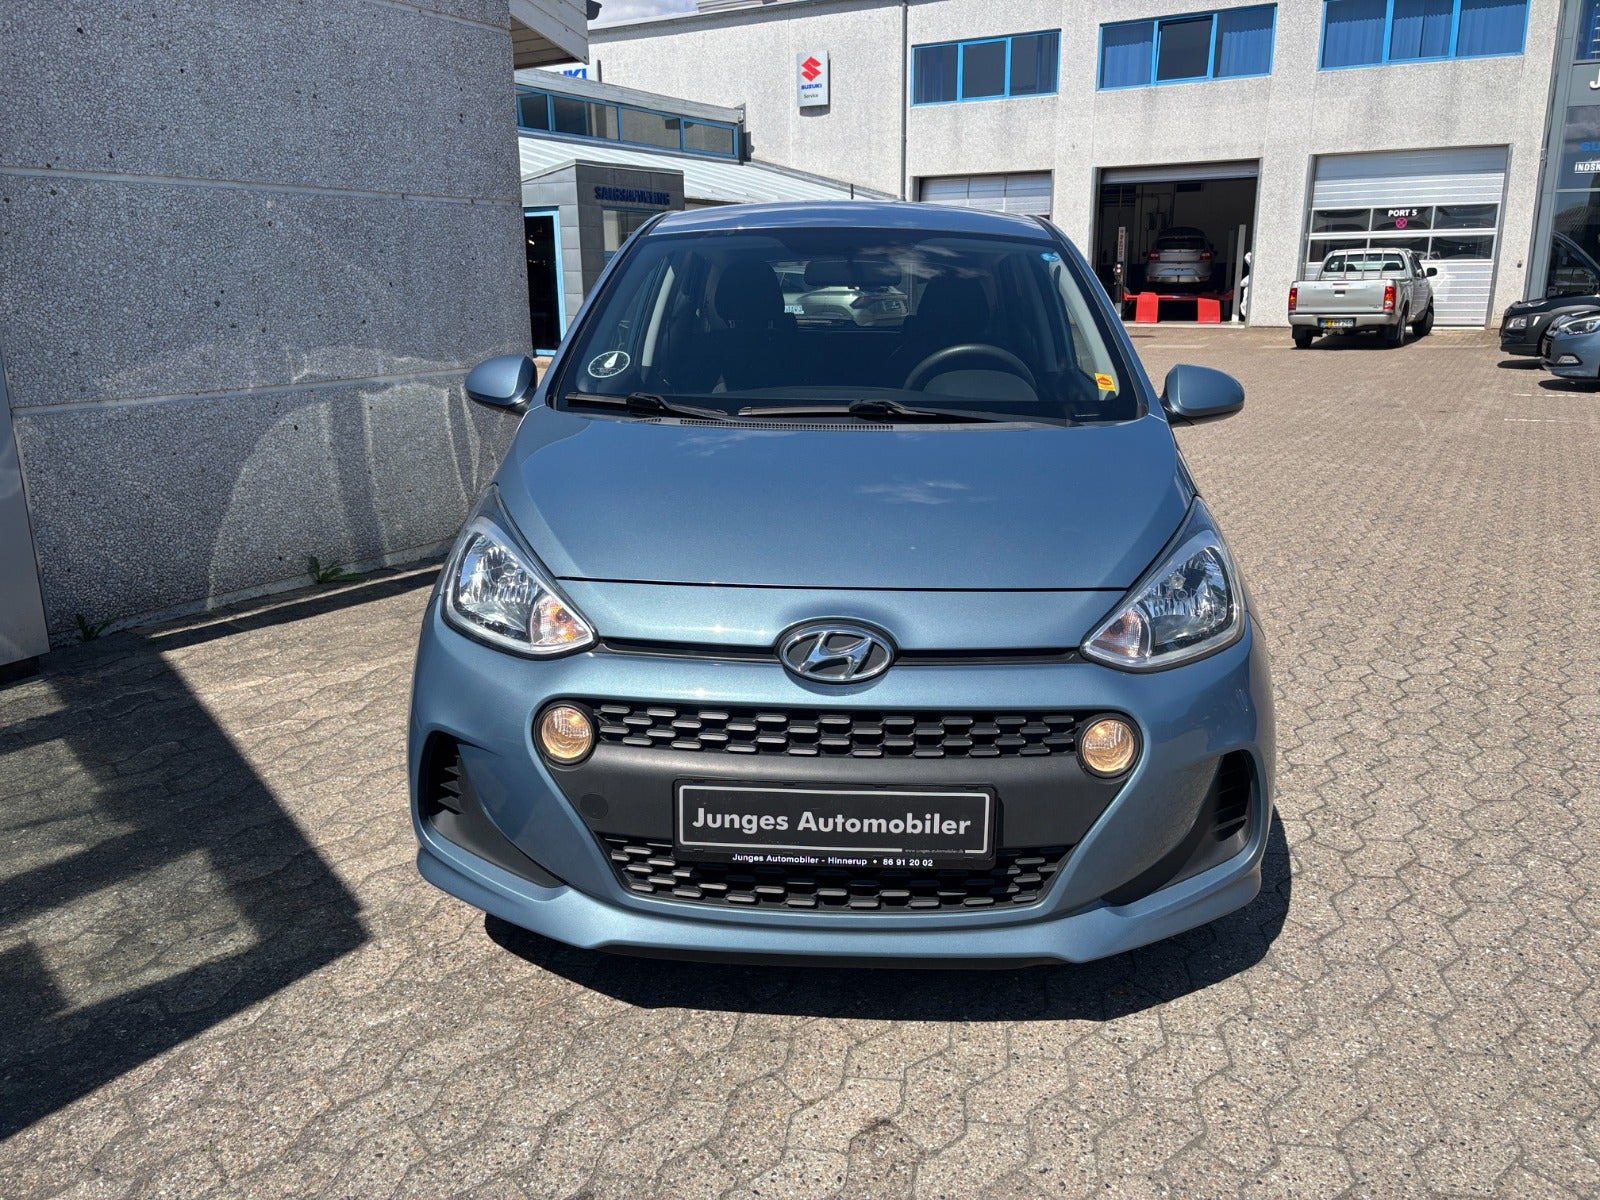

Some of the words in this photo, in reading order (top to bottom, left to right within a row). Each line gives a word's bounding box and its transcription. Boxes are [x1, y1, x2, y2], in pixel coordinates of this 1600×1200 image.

[1387, 209, 1410, 217] PORT
[692, 808, 789, 833] Junges
[797, 811, 971, 834] Automobiler
[732, 853, 764, 862] Junges
[766, 855, 819, 864] Automobiler
[828, 857, 867, 866] Hinnerup
[909, 859, 920, 867] 20
[922, 859, 934, 867] 02
